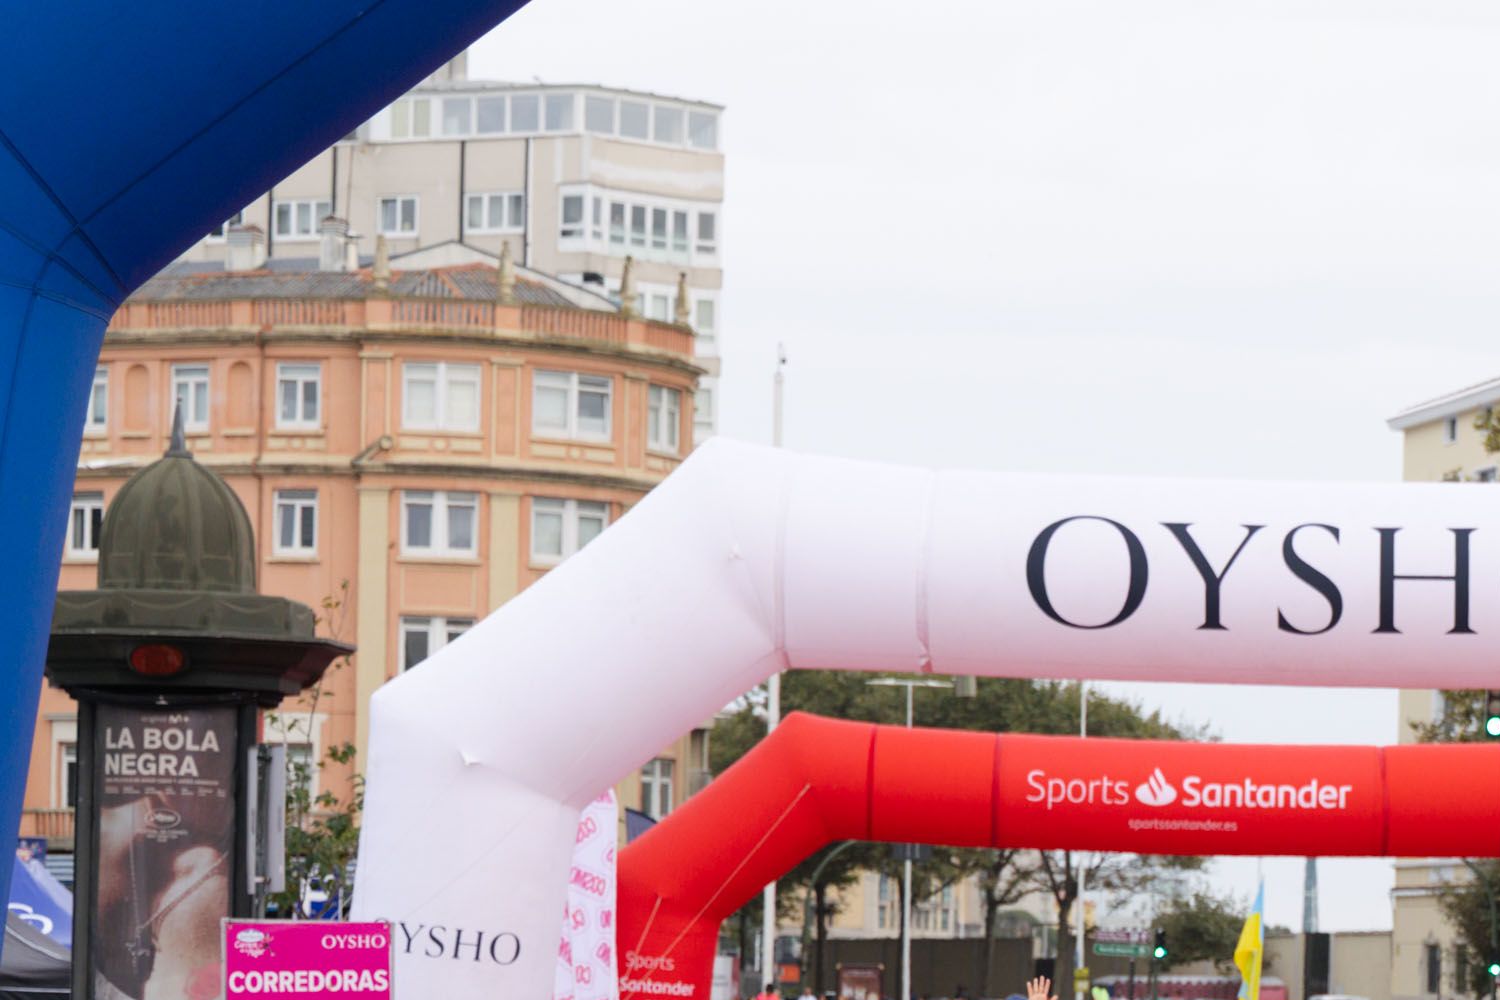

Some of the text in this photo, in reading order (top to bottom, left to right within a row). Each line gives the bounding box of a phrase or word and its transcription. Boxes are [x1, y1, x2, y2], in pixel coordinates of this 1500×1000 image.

[105, 727, 219, 752] LA BOLA
[104, 753, 199, 776] NEGRA
[1025, 769, 1351, 809] Sports Santander
[1128, 818, 1238, 832] sportssantander.es
[321, 934, 386, 950] OYSHO
[374, 918, 521, 966] YSHO
[625, 950, 675, 972] Sports
[228, 970, 389, 994] CORREDORAS
[619, 976, 696, 997] Santander
